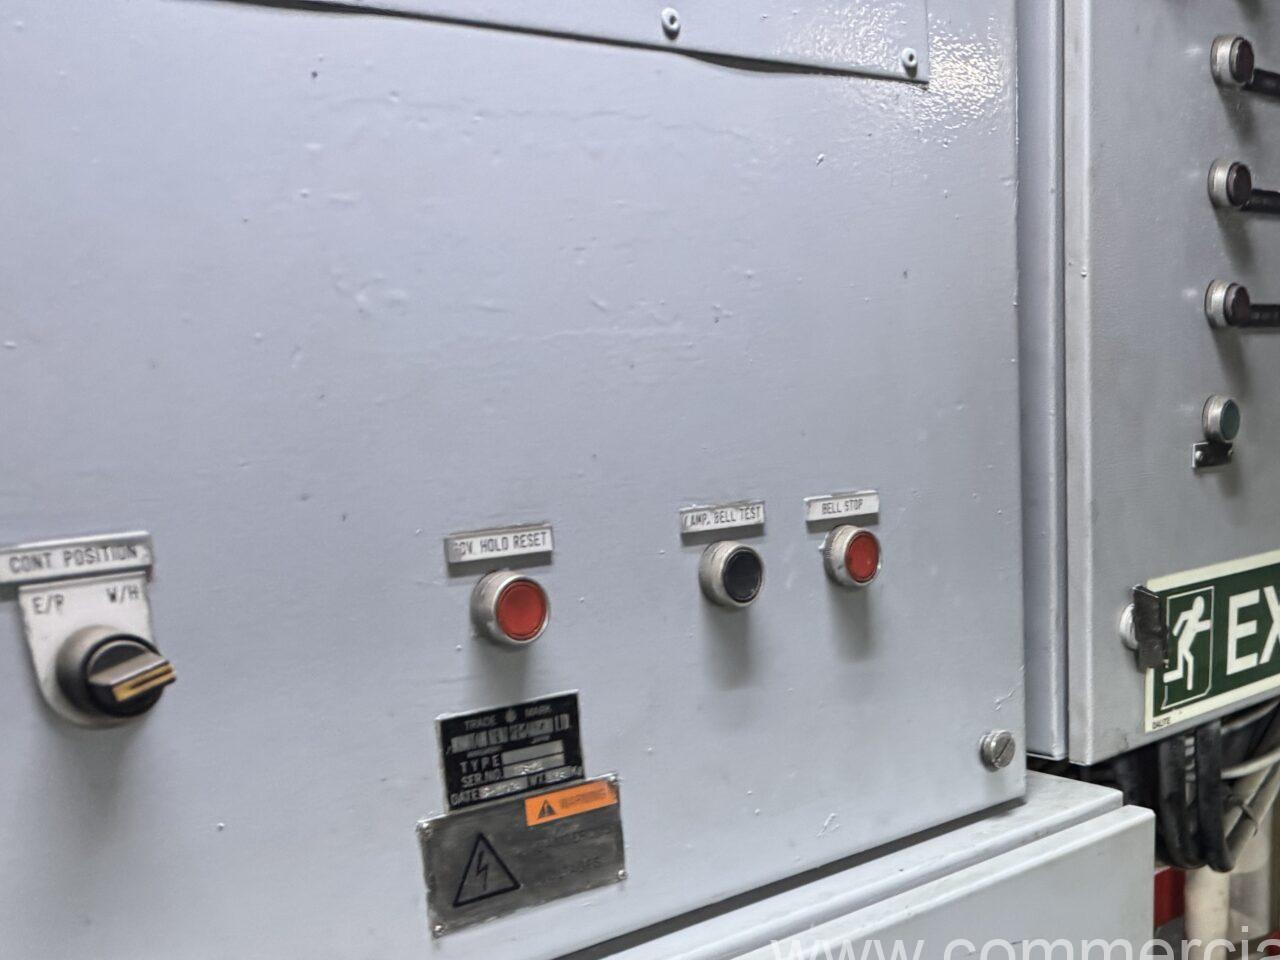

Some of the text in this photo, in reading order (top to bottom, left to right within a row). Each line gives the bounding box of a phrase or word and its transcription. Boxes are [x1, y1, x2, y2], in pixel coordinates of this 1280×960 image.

[713, 511, 737, 525] BELL
[739, 505, 762, 521] TEST
[822, 499, 864, 514] BELL STOP
[480, 536, 509, 554] HOLD
[513, 531, 547, 549] RESET
[9, 545, 138, 574] CONT POSITION
